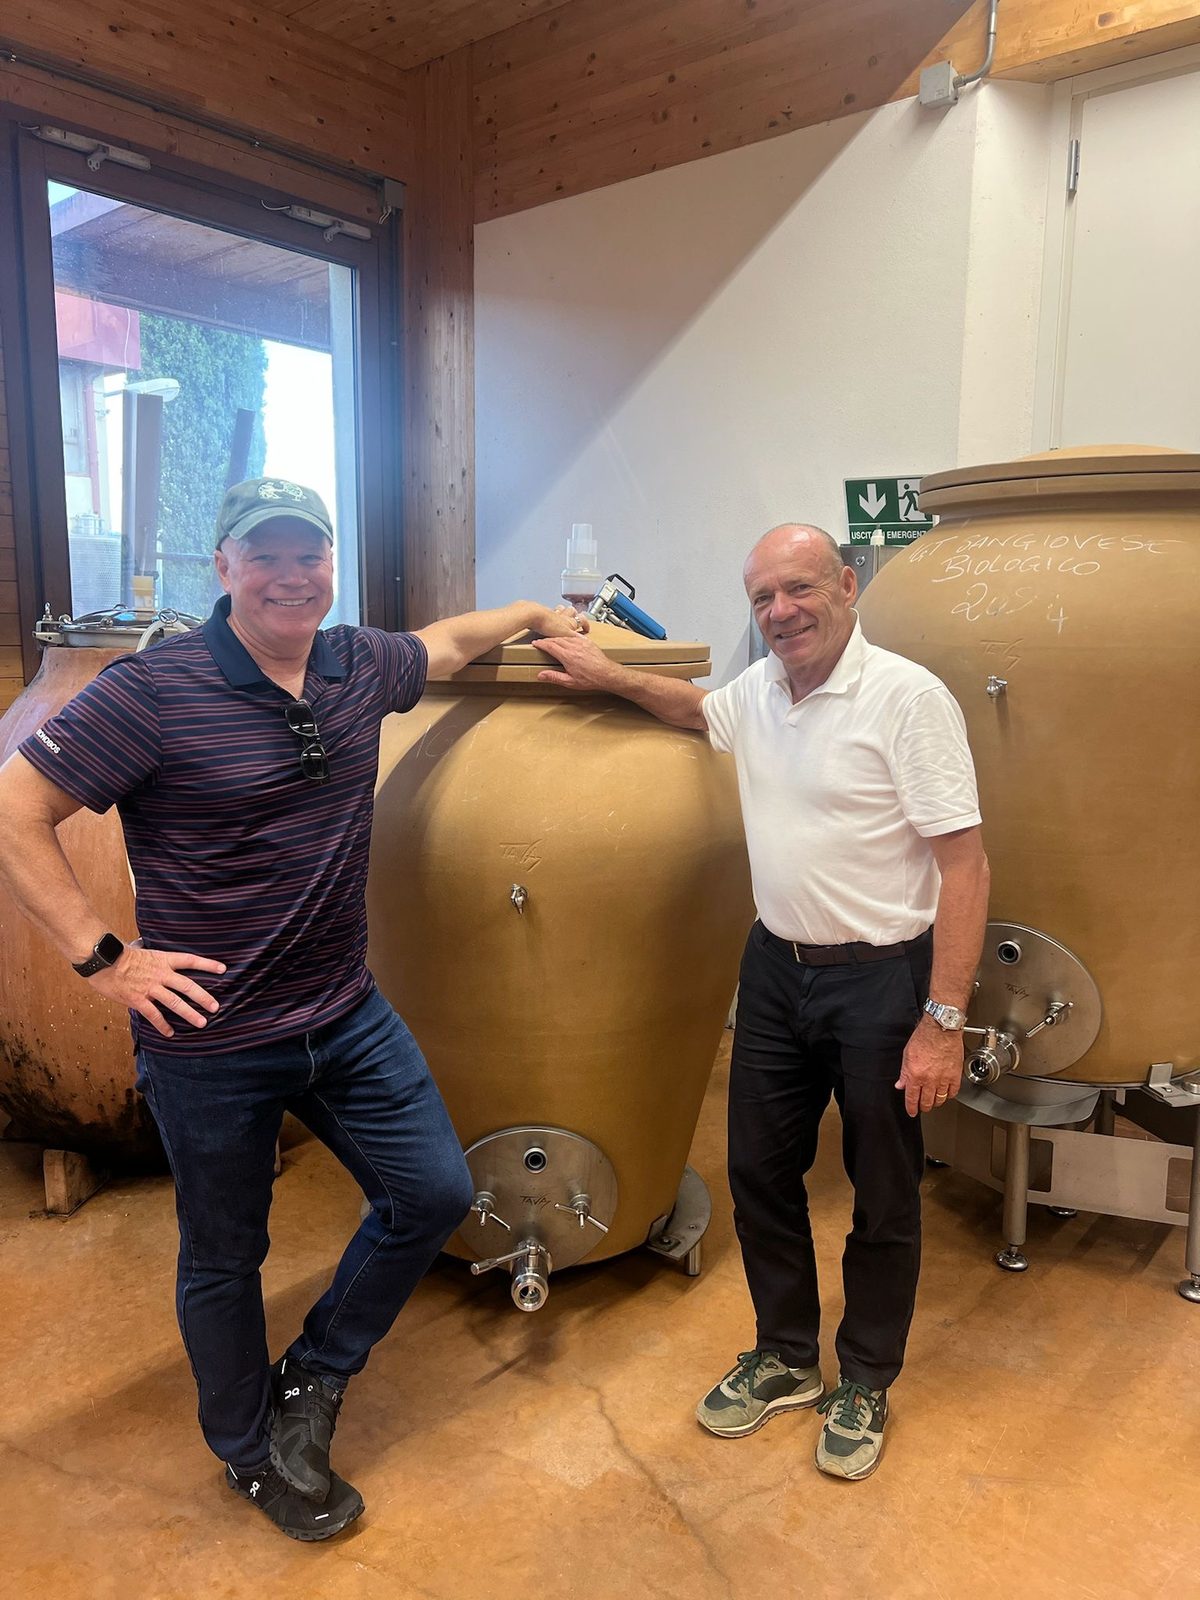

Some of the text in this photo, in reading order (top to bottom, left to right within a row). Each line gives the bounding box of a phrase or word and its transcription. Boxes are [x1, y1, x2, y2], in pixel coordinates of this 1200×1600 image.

[851, 531, 873, 540] USCIT
[886, 530, 927, 539] EMERGEN
[931, 553, 1101, 583] BIOLOGICO
